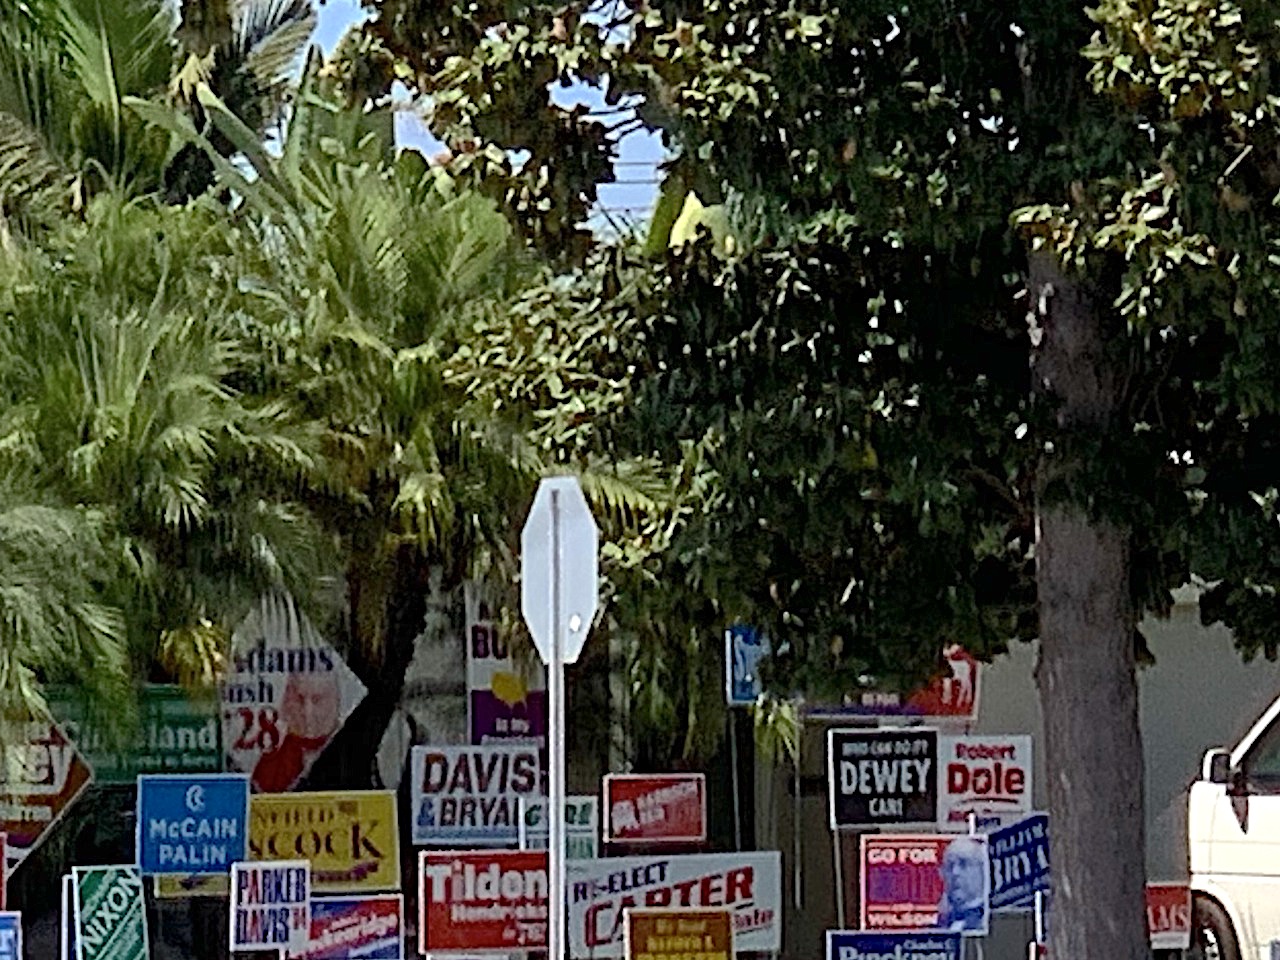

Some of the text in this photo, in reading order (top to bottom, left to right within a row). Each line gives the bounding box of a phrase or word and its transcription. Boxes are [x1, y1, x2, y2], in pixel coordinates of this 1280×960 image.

[422, 753, 537, 795] DAVIS
[840, 758, 931, 795] DEWEY
[947, 763, 1025, 794] Dole
[439, 797, 519, 827] BRYA
[149, 818, 237, 839] McCAIN
[159, 844, 227, 866] PALIN
[867, 849, 938, 865] GO FOR
[237, 868, 306, 902] PARKER
[80, 867, 142, 955] NIXON
